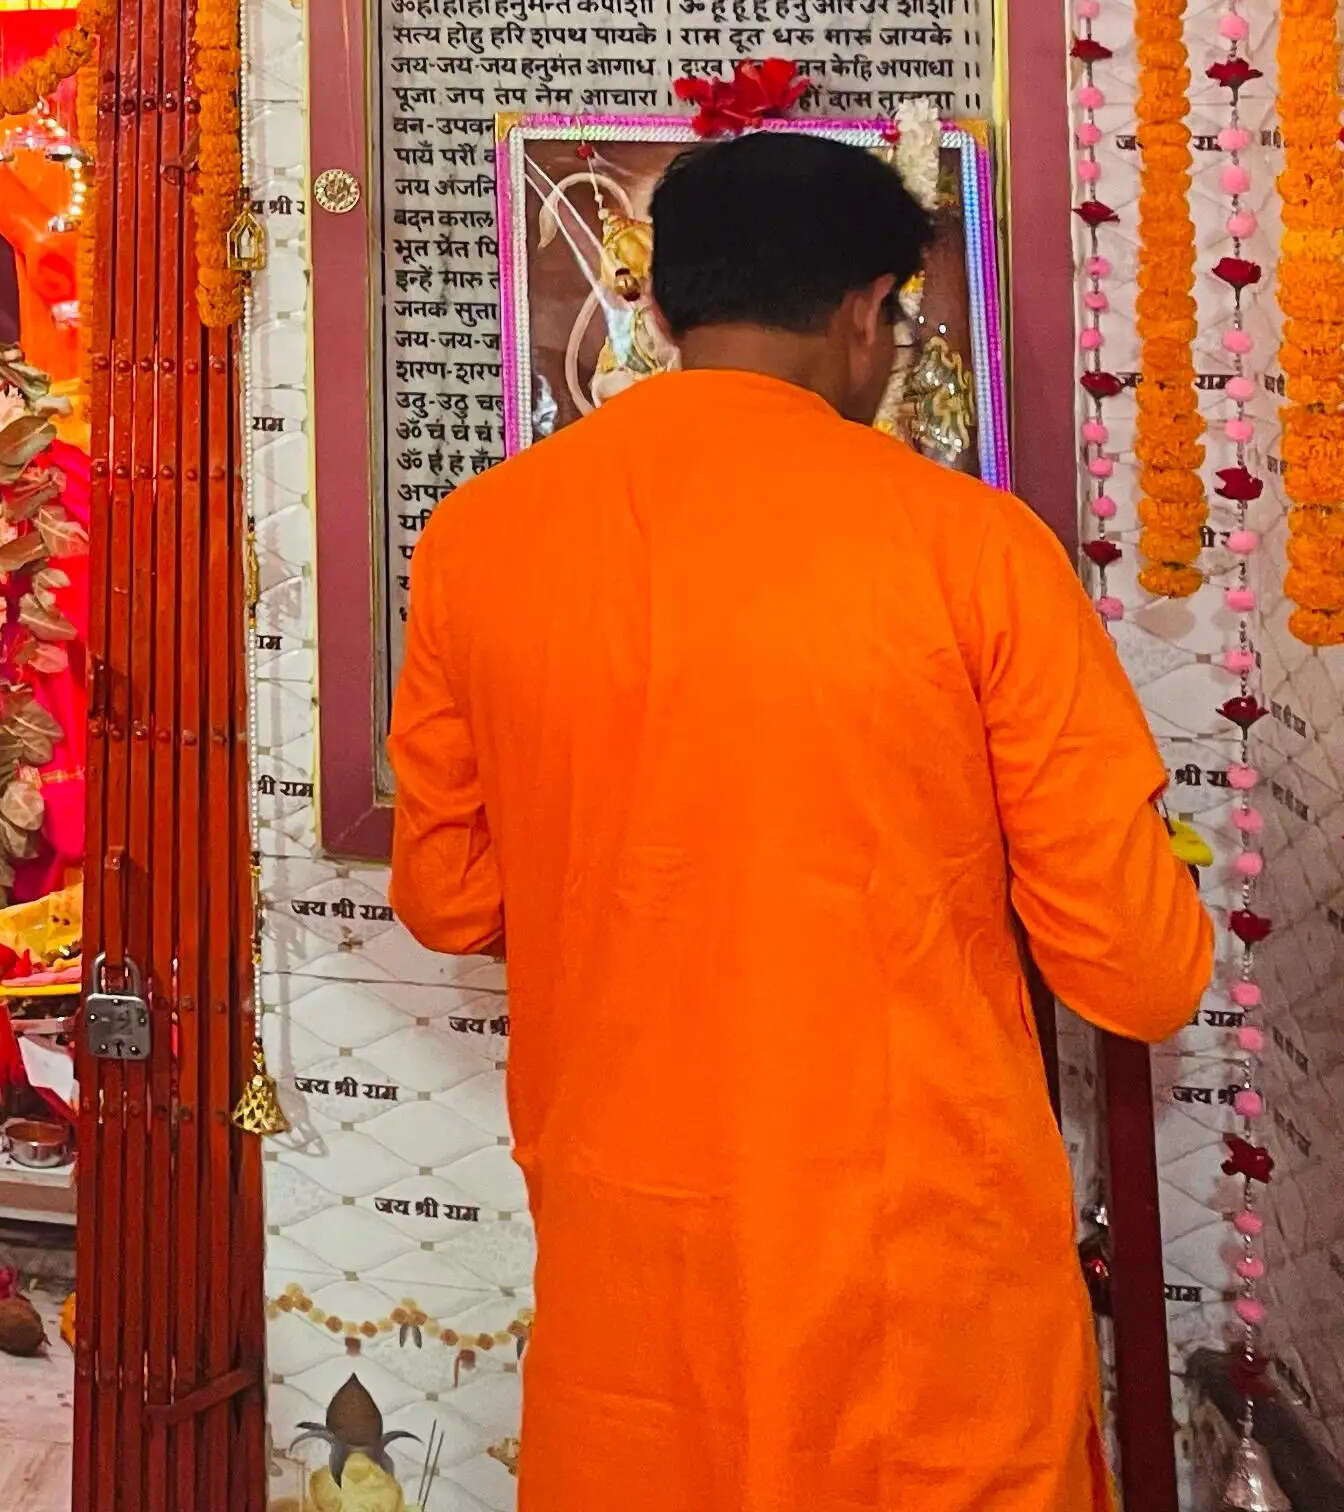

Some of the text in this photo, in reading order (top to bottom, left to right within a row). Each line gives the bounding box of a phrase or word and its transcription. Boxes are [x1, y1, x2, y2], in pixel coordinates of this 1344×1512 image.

[393, 22, 952, 53] सत्य हरि शपथ पायके राम दूत जायके
[392, 83, 657, 112] पूजा जप तप नेम आचारा
[393, 232, 469, 264] भूत प्रेत
[394, 300, 448, 318] जनक
[375, 1197, 480, 1222] जय श्री राम
